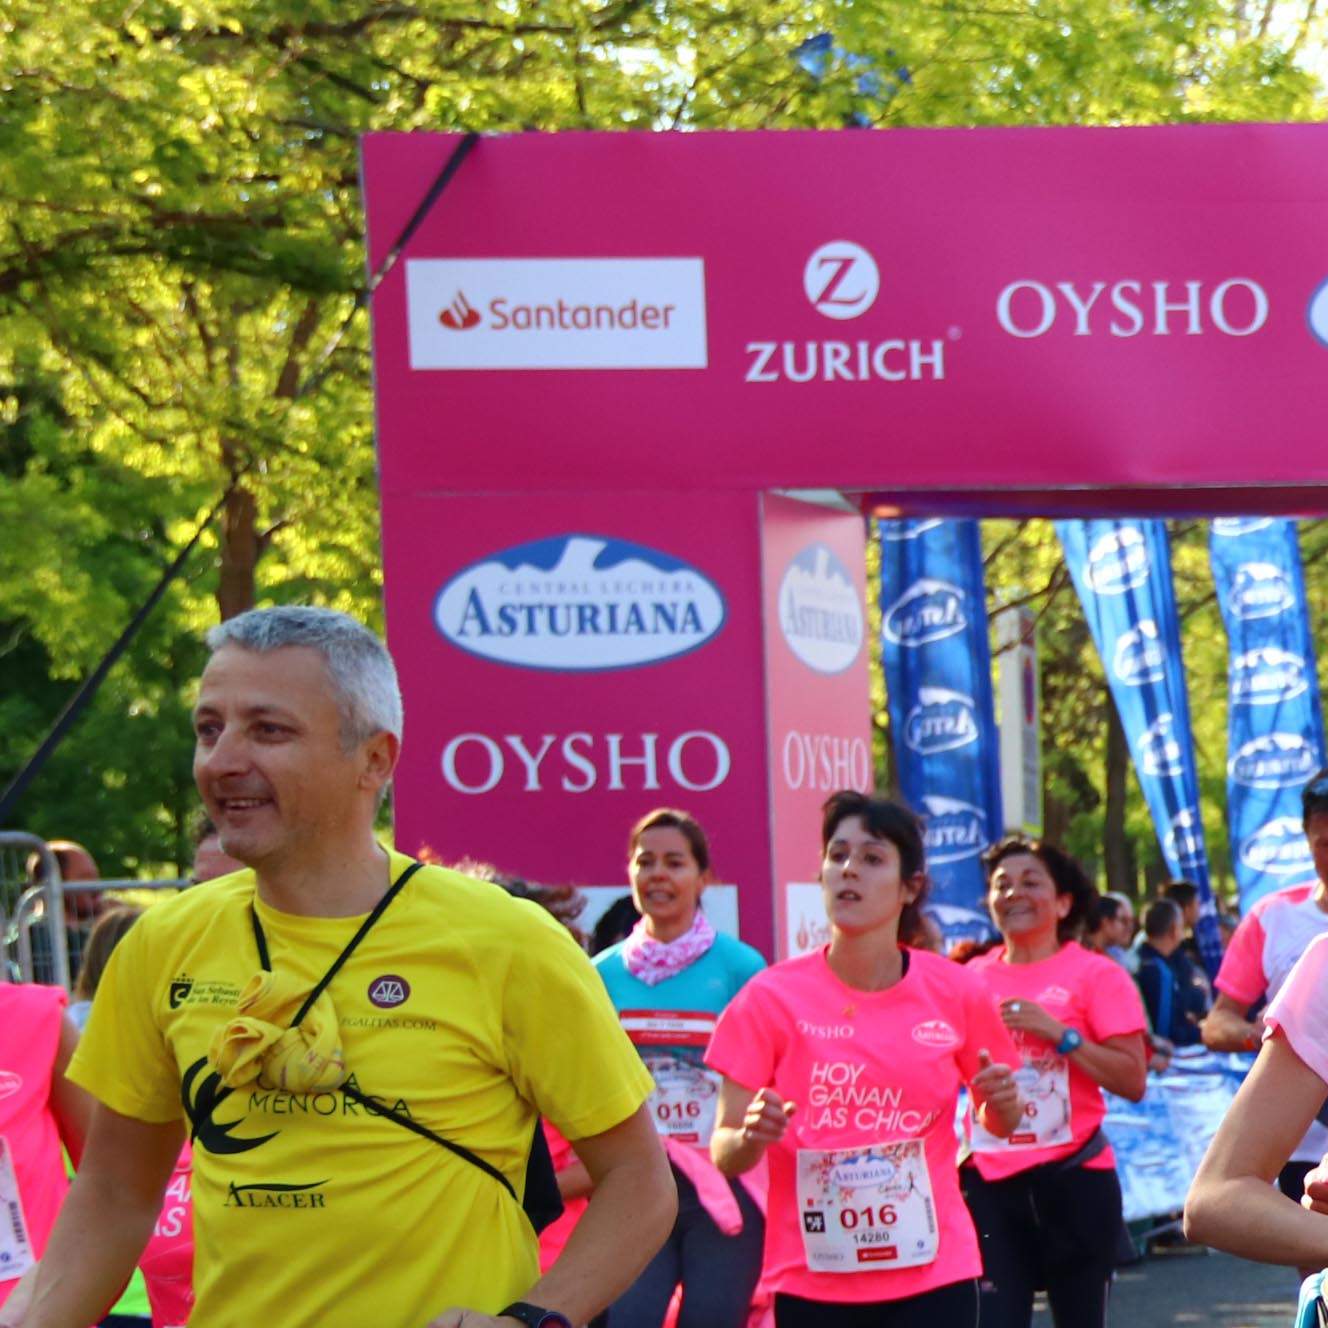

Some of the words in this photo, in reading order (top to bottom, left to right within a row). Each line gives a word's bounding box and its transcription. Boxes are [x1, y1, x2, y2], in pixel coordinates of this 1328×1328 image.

[490, 297, 676, 332] Santander
[997, 277, 1269, 338] OYSHO
[745, 340, 946, 383] ZURICH
[456, 585, 704, 639] ASTURIANA
[441, 729, 731, 796] OYSHO
[782, 730, 870, 794] OYSHO
[810, 1061, 866, 1085] HOY
[656, 1100, 701, 1121] 016
[808, 1084, 903, 1109] GANAN
[810, 1107, 849, 1130] LAS
[224, 1180, 327, 1209] ALACER
[839, 1204, 898, 1230] 016
